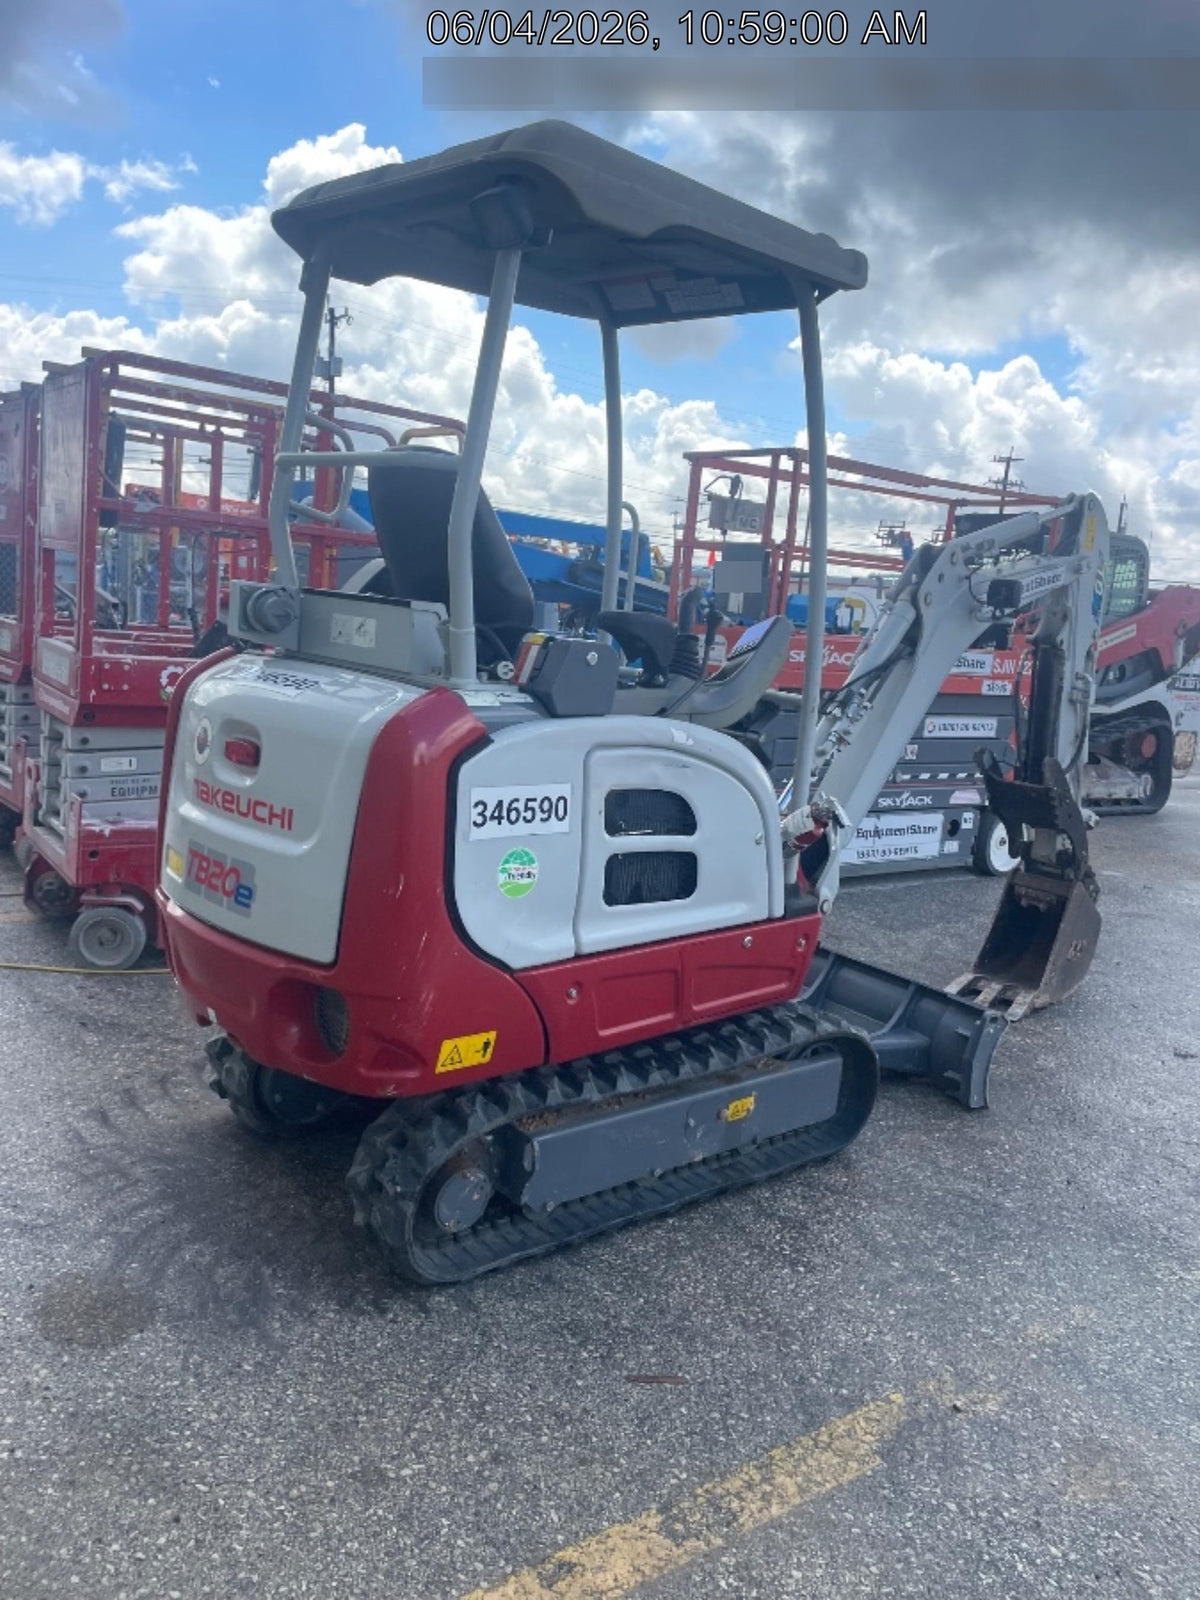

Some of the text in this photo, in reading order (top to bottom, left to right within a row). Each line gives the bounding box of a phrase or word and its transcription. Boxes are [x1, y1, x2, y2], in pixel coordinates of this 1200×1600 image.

[472, 795, 568, 829] 346590
[878, 790, 933, 808] SKYJACK
[186, 846, 254, 909] TB20e
